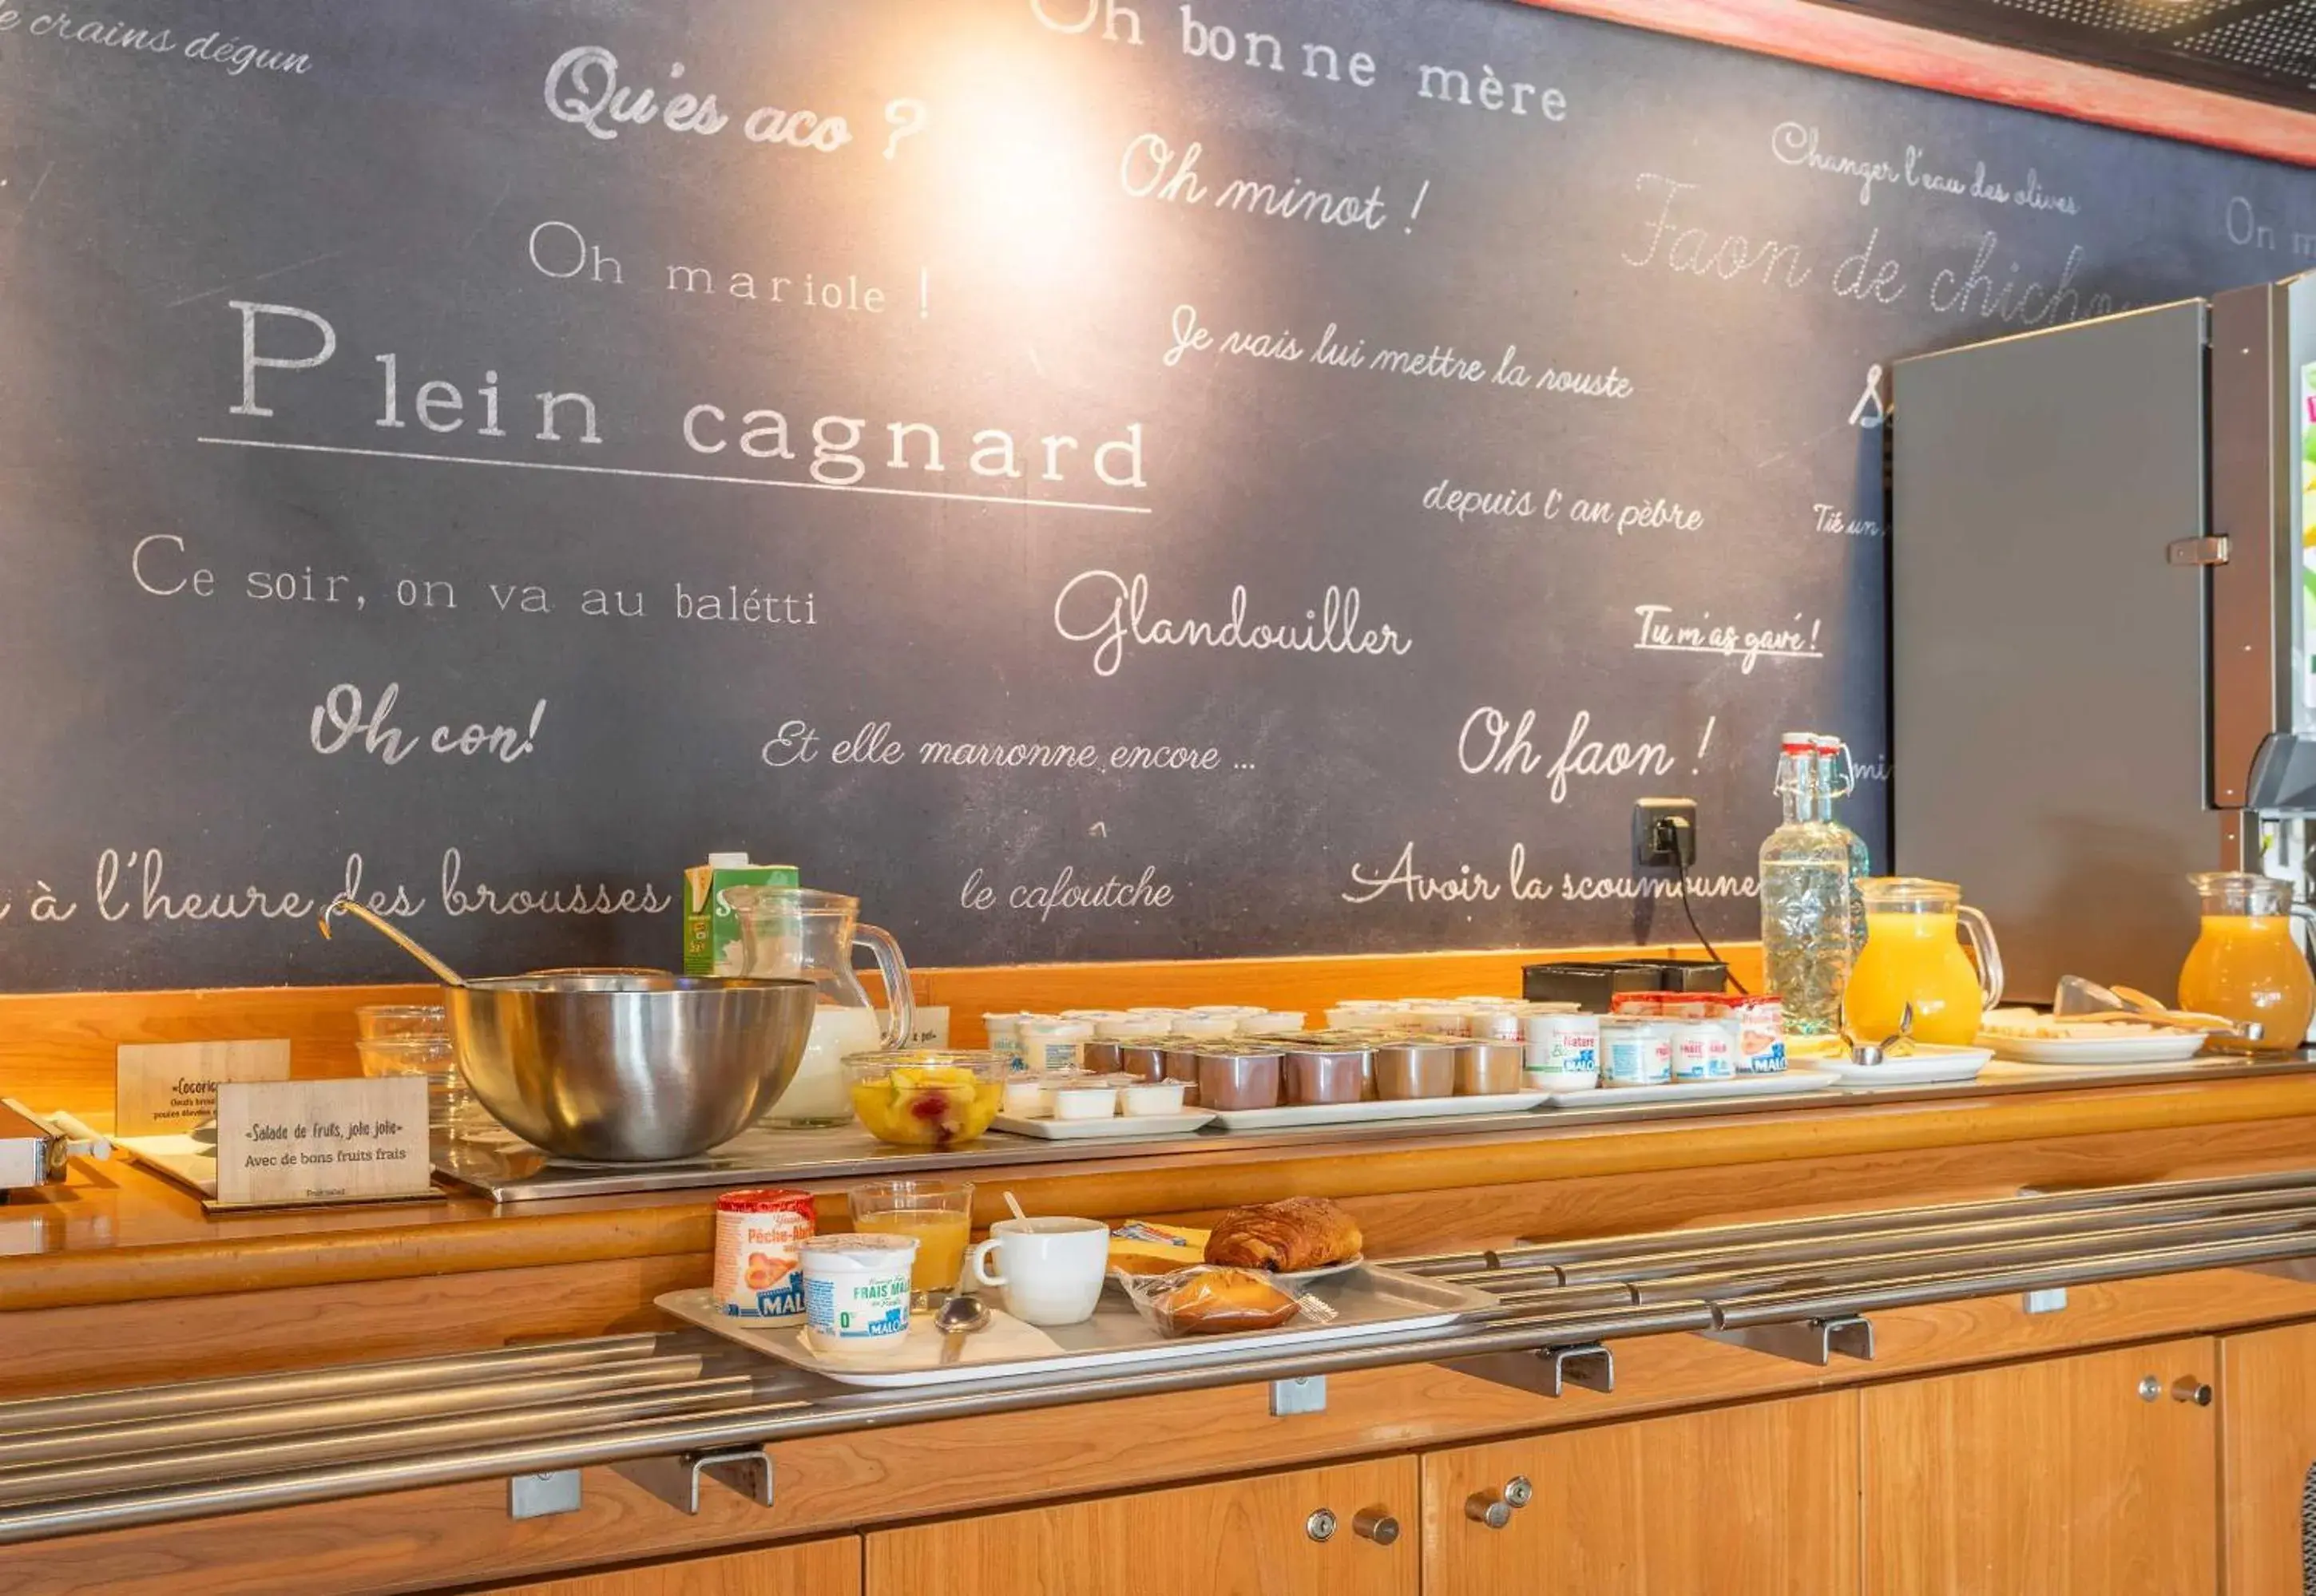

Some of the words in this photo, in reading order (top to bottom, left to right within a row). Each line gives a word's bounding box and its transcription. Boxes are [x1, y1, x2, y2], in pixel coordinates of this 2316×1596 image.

[30, 11, 176, 53] crains
[184, 32, 314, 76] dégun
[1029, 0, 1144, 46] Oh
[1180, 4, 1377, 87] bonne
[1418, 63, 1568, 121] mère
[544, 46, 729, 140] Qu'es
[743, 105, 852, 152] aco
[1120, 133, 1207, 204] Oh
[1216, 176, 1387, 234] minot
[1404, 180, 1430, 235] !
[1771, 121, 1898, 206] Changer
[1906, 146, 1966, 196] l'eau
[1969, 161, 2010, 204] des
[2013, 168, 2080, 217] olives
[1620, 170, 1814, 291] Faon
[1831, 226, 1908, 305] de
[2226, 196, 2275, 251] On
[528, 220, 625, 285] Oh
[666, 264, 886, 315] mariole
[918, 266, 930, 319] !
[228, 299, 603, 445] Plein
[683, 403, 1148, 488] cagnard
[1162, 304, 1213, 367] Je
[1220, 329, 1303, 362] vais
[1309, 322, 1366, 369] lui
[1370, 347, 1486, 383] mettre
[1490, 345, 1532, 388] la
[1535, 366, 1634, 399] rouste
[1422, 479, 1537, 522] depuis
[1616, 498, 1704, 537] pèbre
[131, 533, 216, 599] Ce
[246, 567, 367, 611] soir,
[397, 575, 458, 609] on
[489, 582, 552, 614] va
[581, 587, 648, 618] au
[674, 582, 818, 626] balétti
[1053, 570, 1413, 677] Glandouiller
[1635, 604, 1673, 646] Tu
[310, 682, 420, 766] Oh
[430, 699, 548, 763] con!
[760, 719, 819, 767] Et
[831, 721, 905, 766] elle
[920, 739, 1097, 768] marronne
[1109, 740, 1221, 770] encore
[1457, 706, 1541, 775] Oh
[1546, 711, 1675, 804] faon
[1691, 716, 1716, 776] !
[30, 879, 77, 921] à
[96, 848, 315, 922] l'heure
[319, 853, 426, 917] des
[442, 847, 671, 917] brousses
[960, 869, 997, 910] le
[1008, 865, 1174, 923] cafoutche
[1342, 841, 1501, 903] Avoir
[1510, 842, 1554, 900] la
[1561, 873, 1760, 901] scoumoune
[244, 1154, 277, 1168] Avec
[280, 1153, 297, 1166] de
[299, 1152, 334, 1165] bons
[336, 1150, 373, 1163] fruits
[375, 1147, 408, 1162] frais
[294, 1123, 307, 1139] de
[853, 1283, 888, 1300] FRAIS
